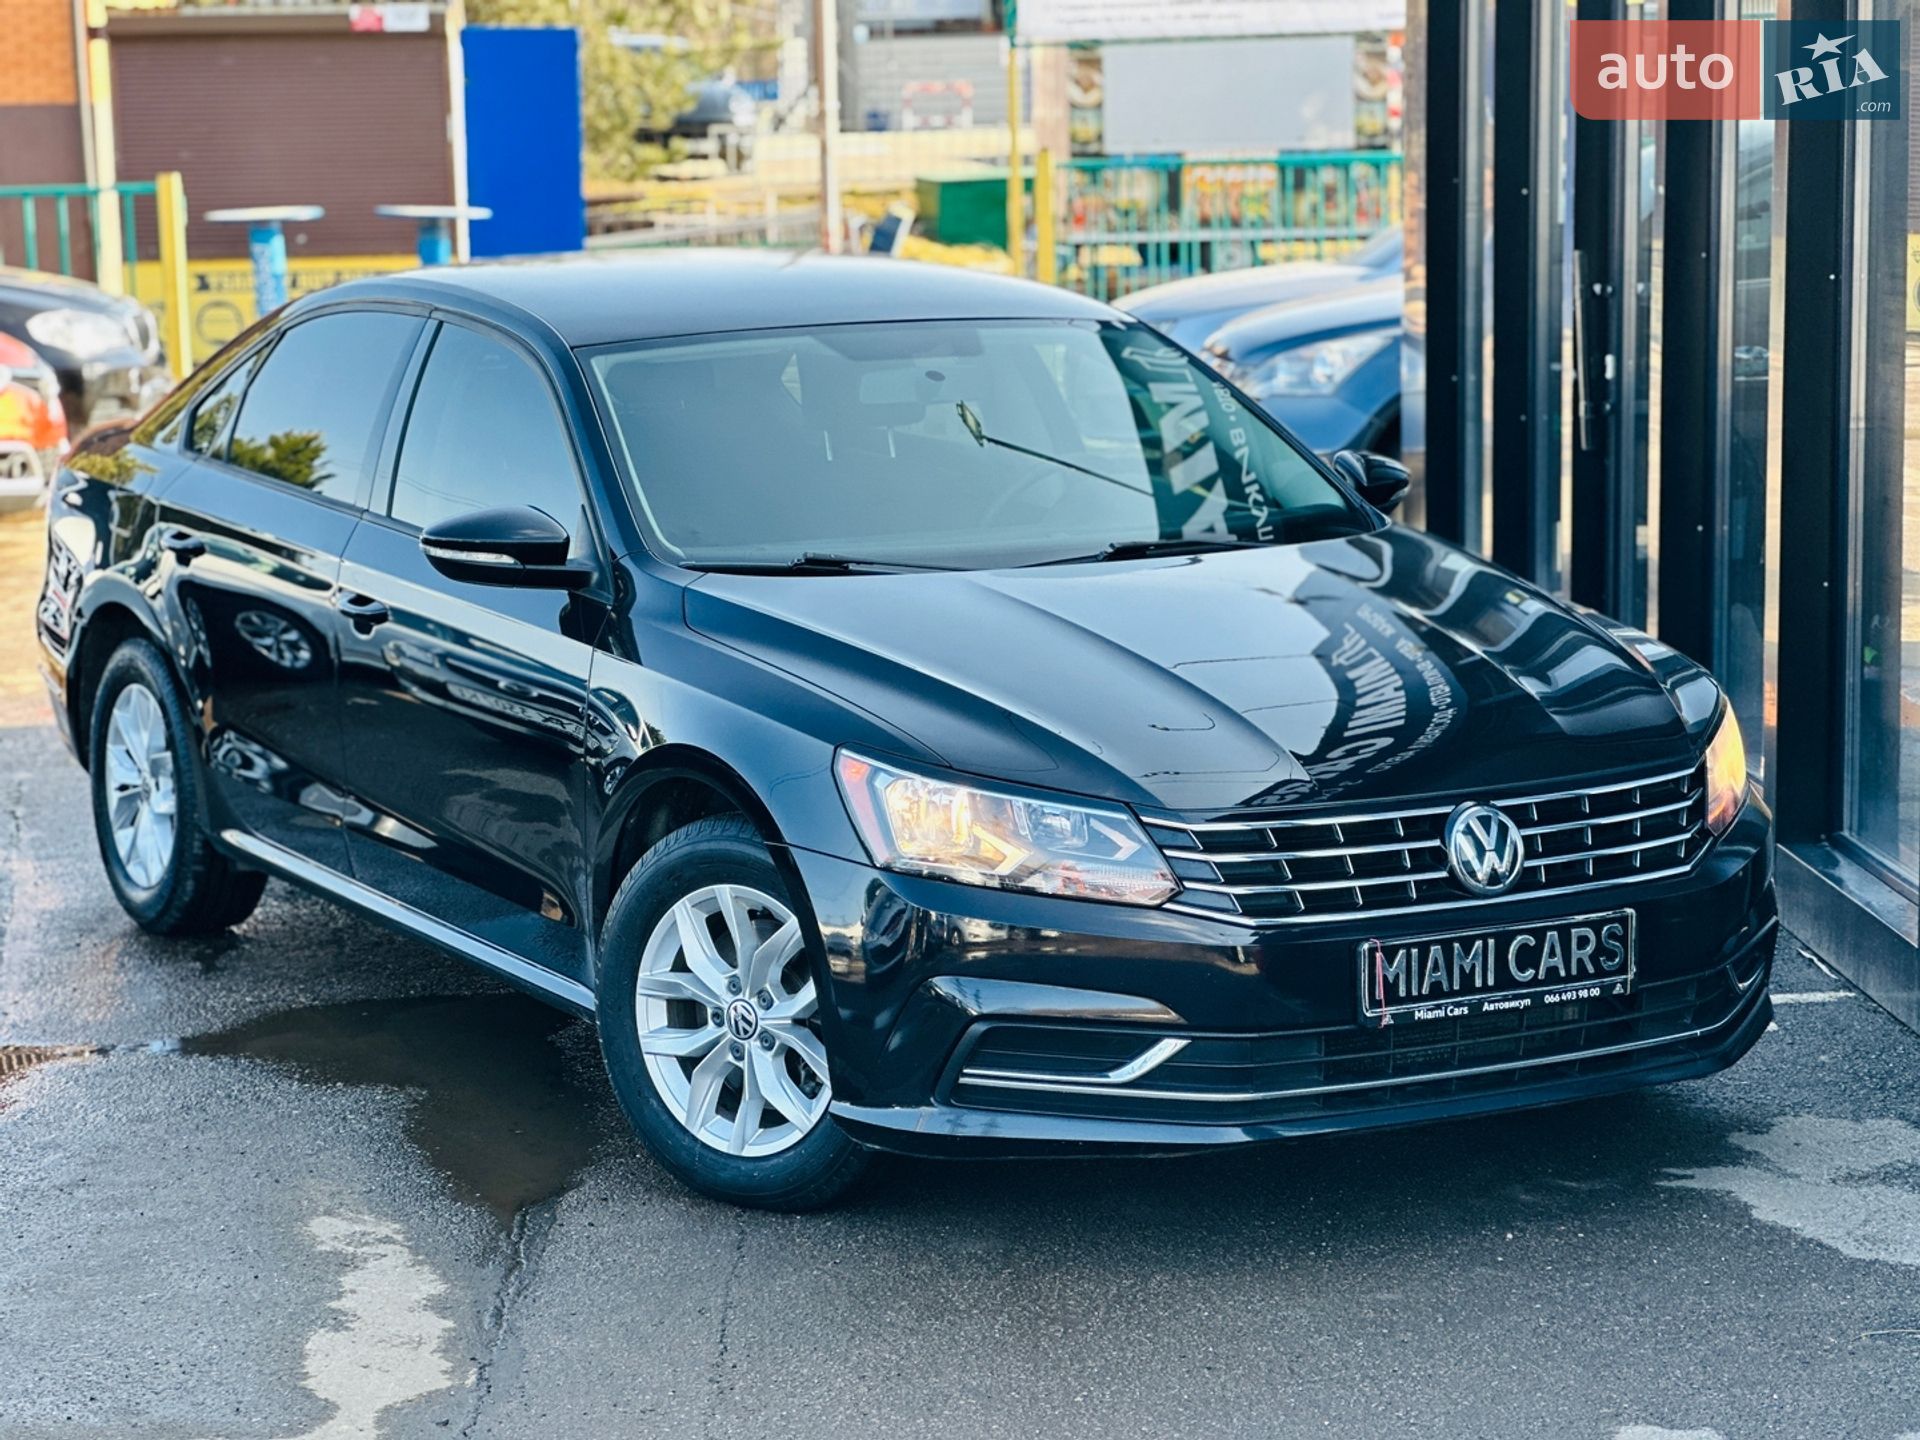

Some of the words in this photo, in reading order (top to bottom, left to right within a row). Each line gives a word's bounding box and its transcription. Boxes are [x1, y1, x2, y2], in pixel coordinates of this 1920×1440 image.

[1375, 938, 1496, 1001] MIAMI
[1508, 923, 1625, 983] CARS
[1544, 993, 1560, 1004] 066
[1561, 990, 1577, 1001] 493
[1577, 988, 1589, 999] 98
[1589, 986, 1600, 997] 00
[1414, 1006, 1446, 1021] Miami
[1446, 1005, 1469, 1017] Cars
[1482, 997, 1531, 1013] Автовикуп
